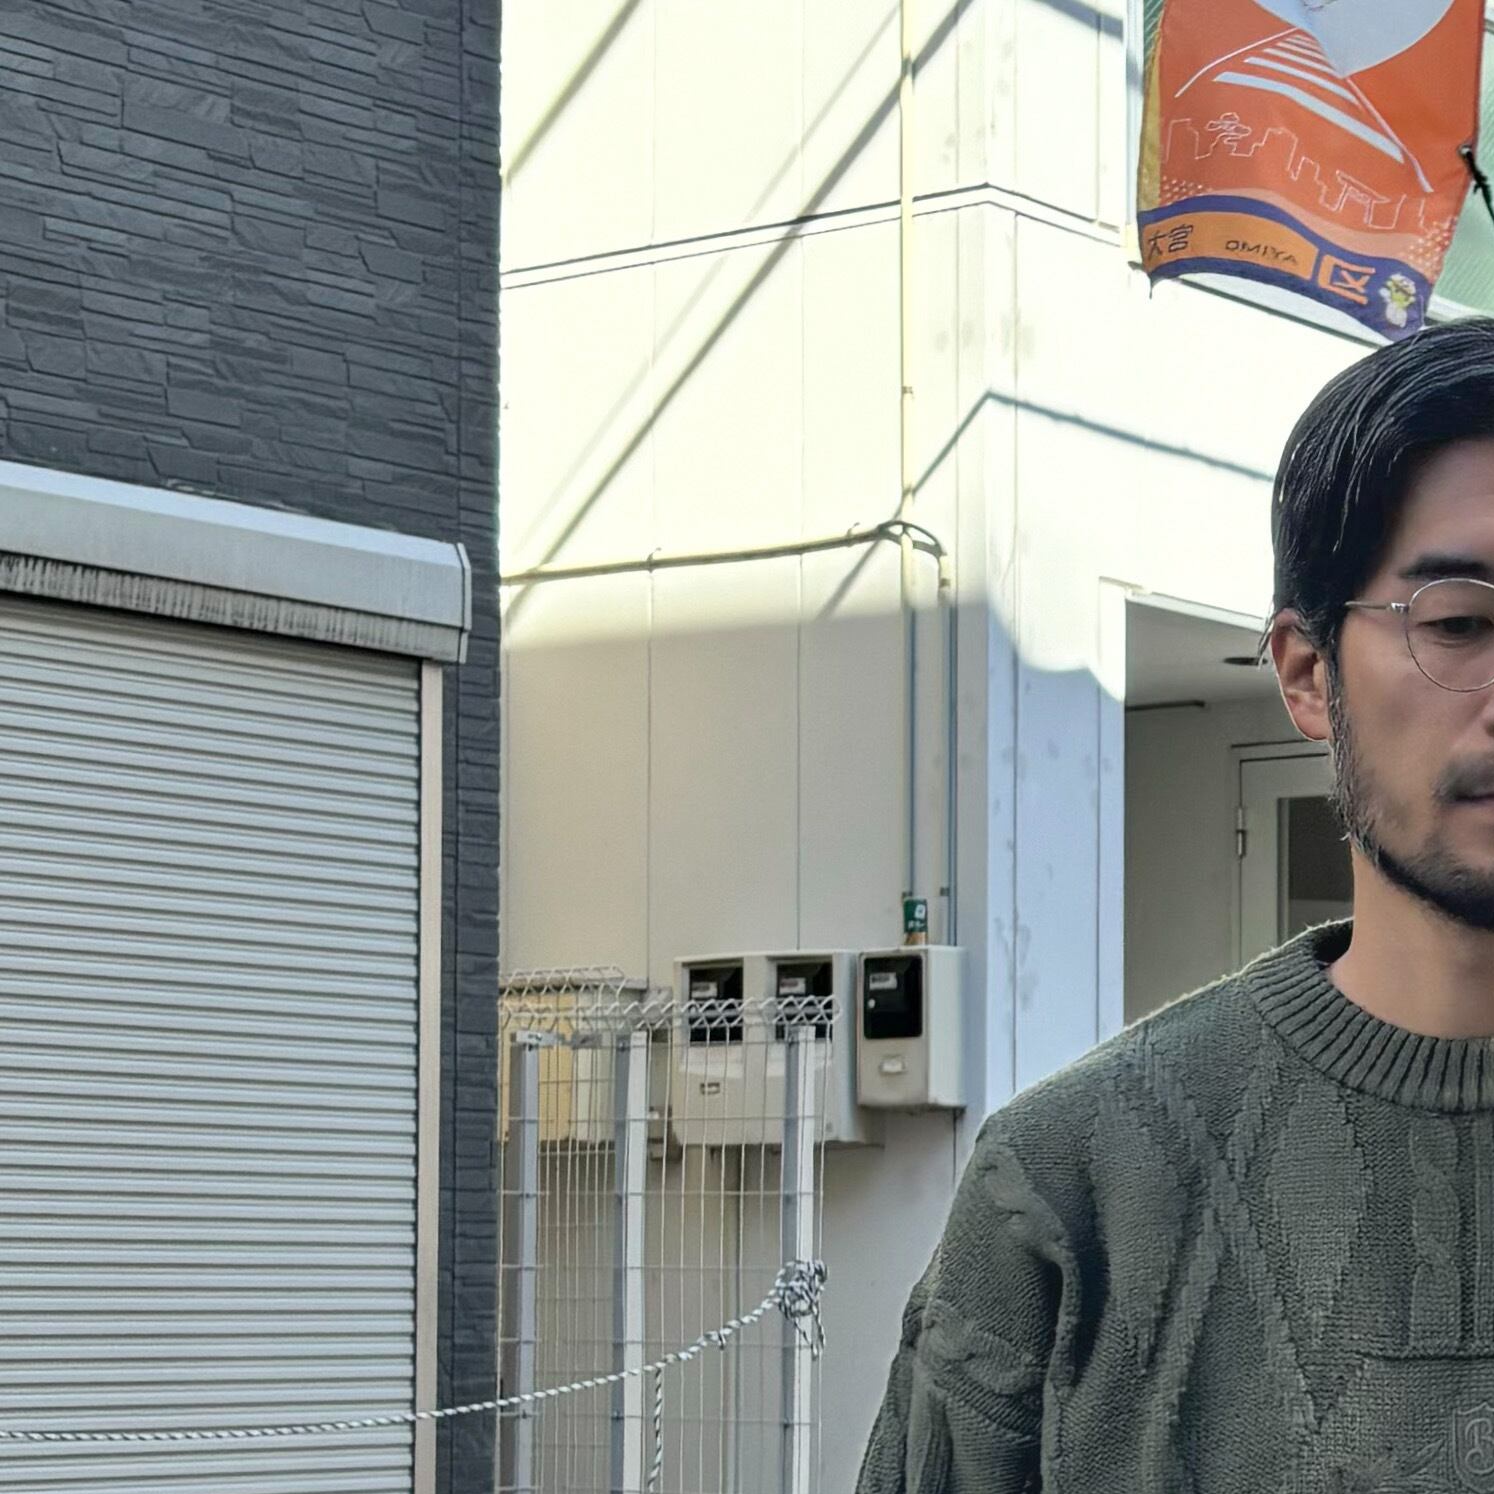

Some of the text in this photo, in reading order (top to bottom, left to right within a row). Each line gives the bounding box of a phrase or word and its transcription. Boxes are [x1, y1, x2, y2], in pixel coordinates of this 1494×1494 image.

[1148, 224, 1376, 304] 大宮 OMIYA 区
